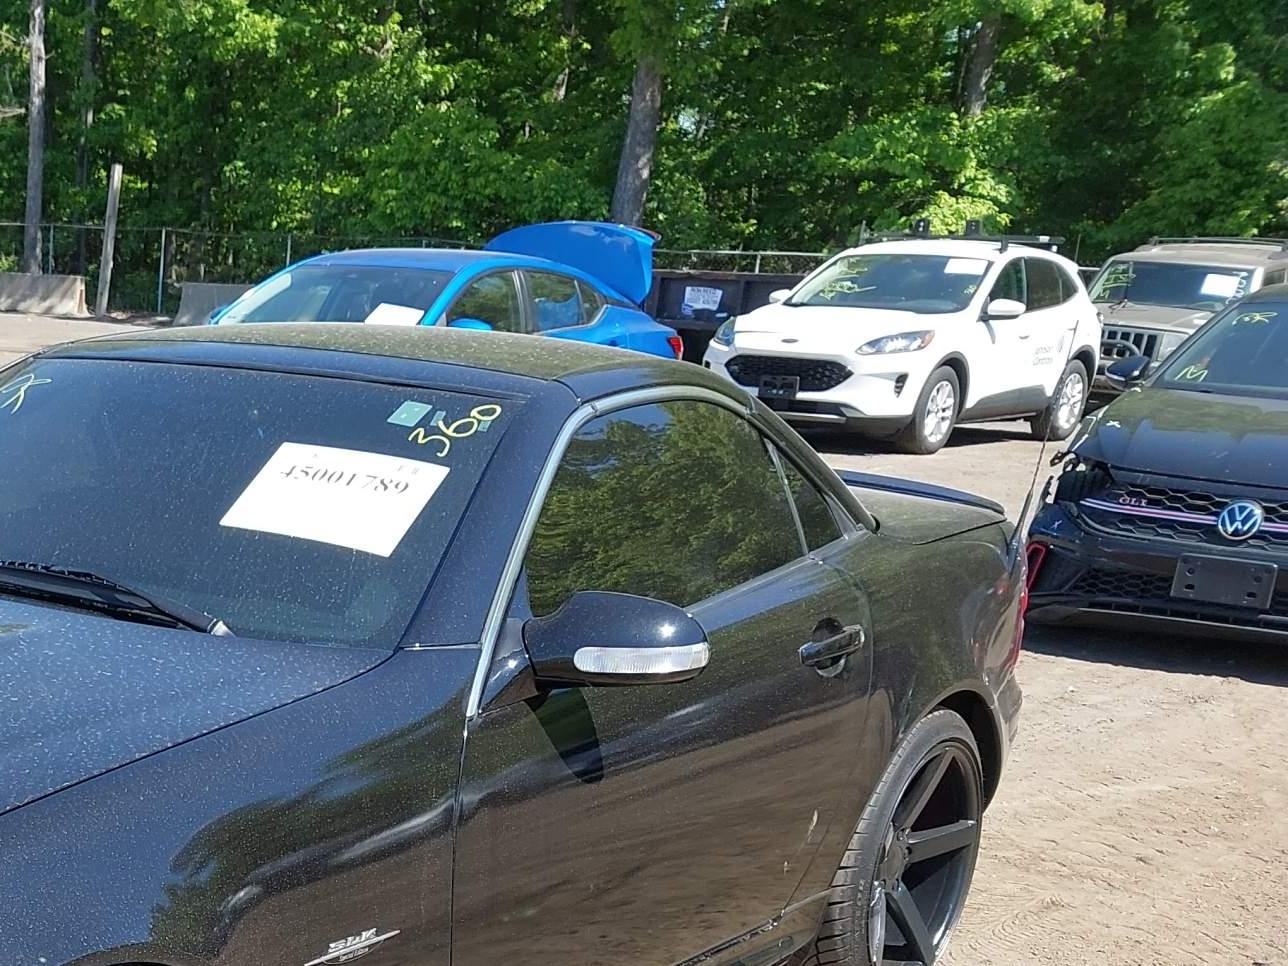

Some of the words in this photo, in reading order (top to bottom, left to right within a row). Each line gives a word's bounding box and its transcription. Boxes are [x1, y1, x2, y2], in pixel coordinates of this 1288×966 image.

[408, 404, 502, 457] 360
[280, 465, 410, 494] 45001789
[327, 927, 377, 953] SLK
